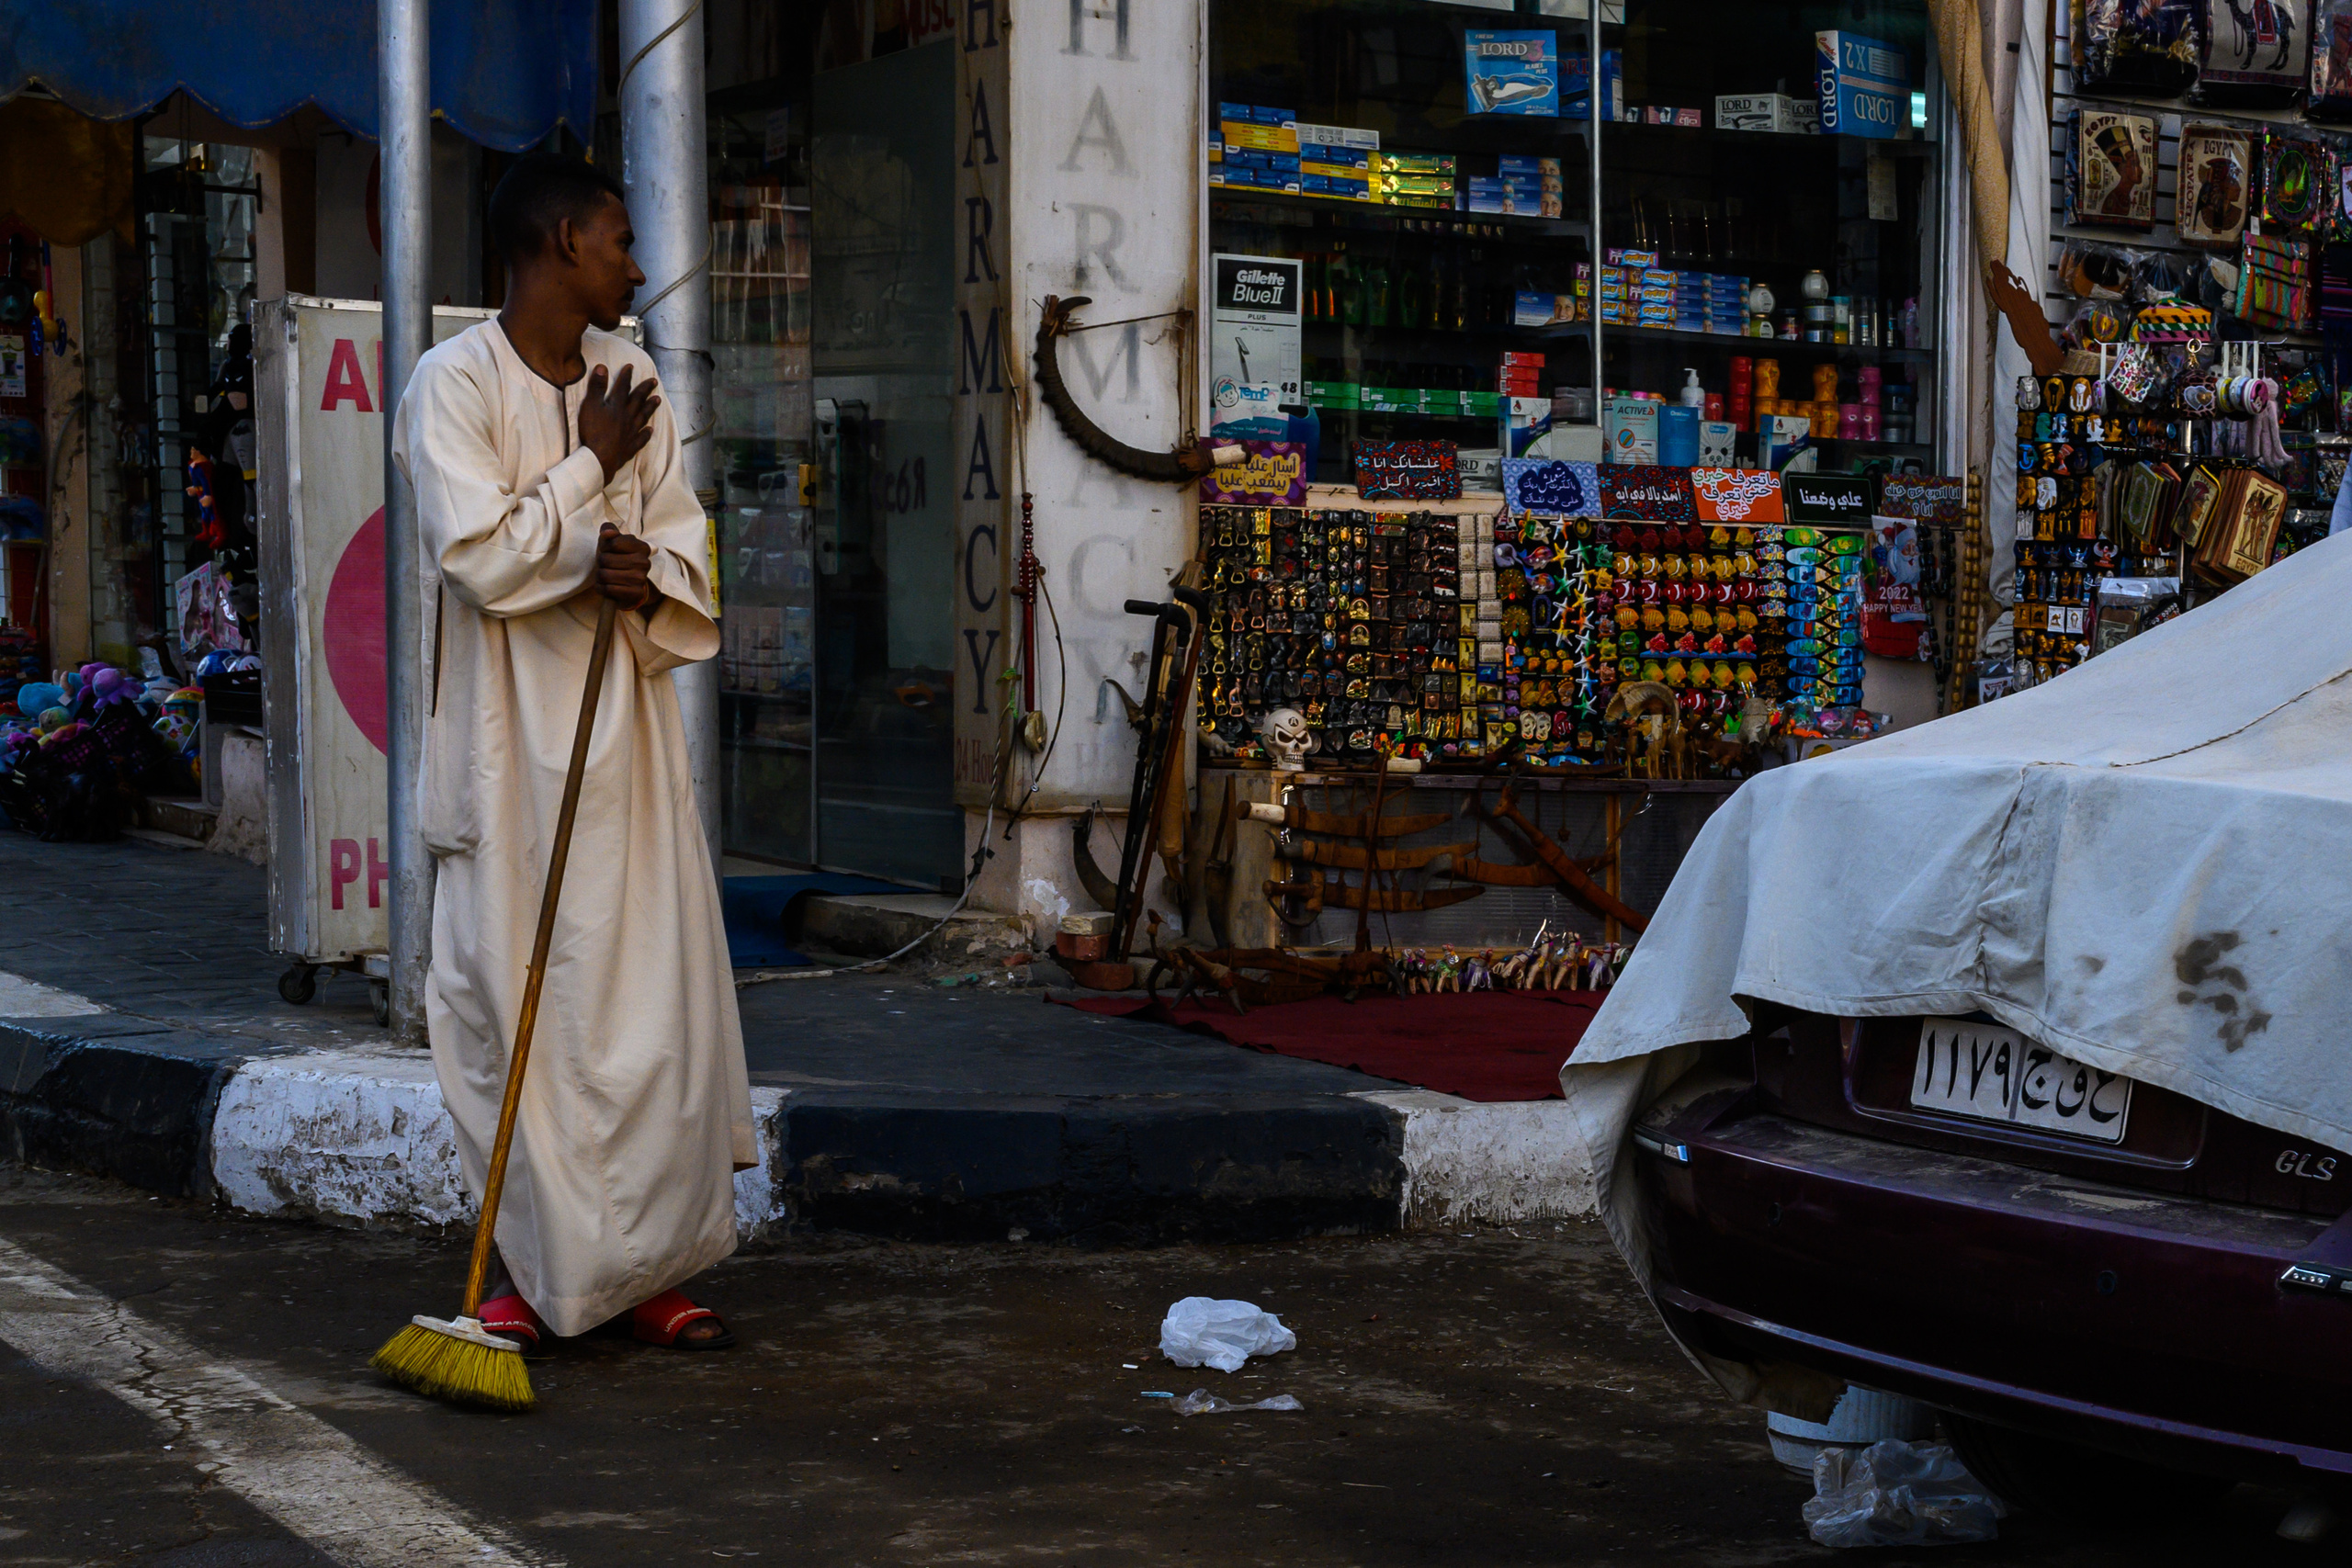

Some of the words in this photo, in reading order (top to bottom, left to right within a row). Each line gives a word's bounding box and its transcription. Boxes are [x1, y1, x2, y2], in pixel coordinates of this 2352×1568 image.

[1482, 42, 1527, 56] LORD
[1528, 39, 1545, 62] 3
[1721, 99, 1751, 111] LORD
[1821, 67, 1837, 128] LORD
[1854, 93, 1896, 125] LORD
[2085, 116, 2117, 137] EGYPT
[2203, 140, 2233, 158] EGYPT
[2184, 141, 2195, 228] CLEOPATRA
[1236, 269, 1285, 286] Gillette
[1281, 382, 1297, 394] 48
[1618, 406, 1647, 415] ACTIVE
[1529, 417, 1537, 428] 3
[1373, 457, 1386, 468] انا
[1390, 454, 1441, 468] علشانك
[1456, 459, 1479, 471] ORD
[2235, 558, 2258, 573] EGYPT
[1879, 586, 1909, 600] 2022
[1863, 603, 1888, 613] HAPPY
[1890, 604, 1907, 613] NEW
[1925, 1030, 2011, 1108] ١١٧٩
[2274, 1148, 2338, 1182] GLS
